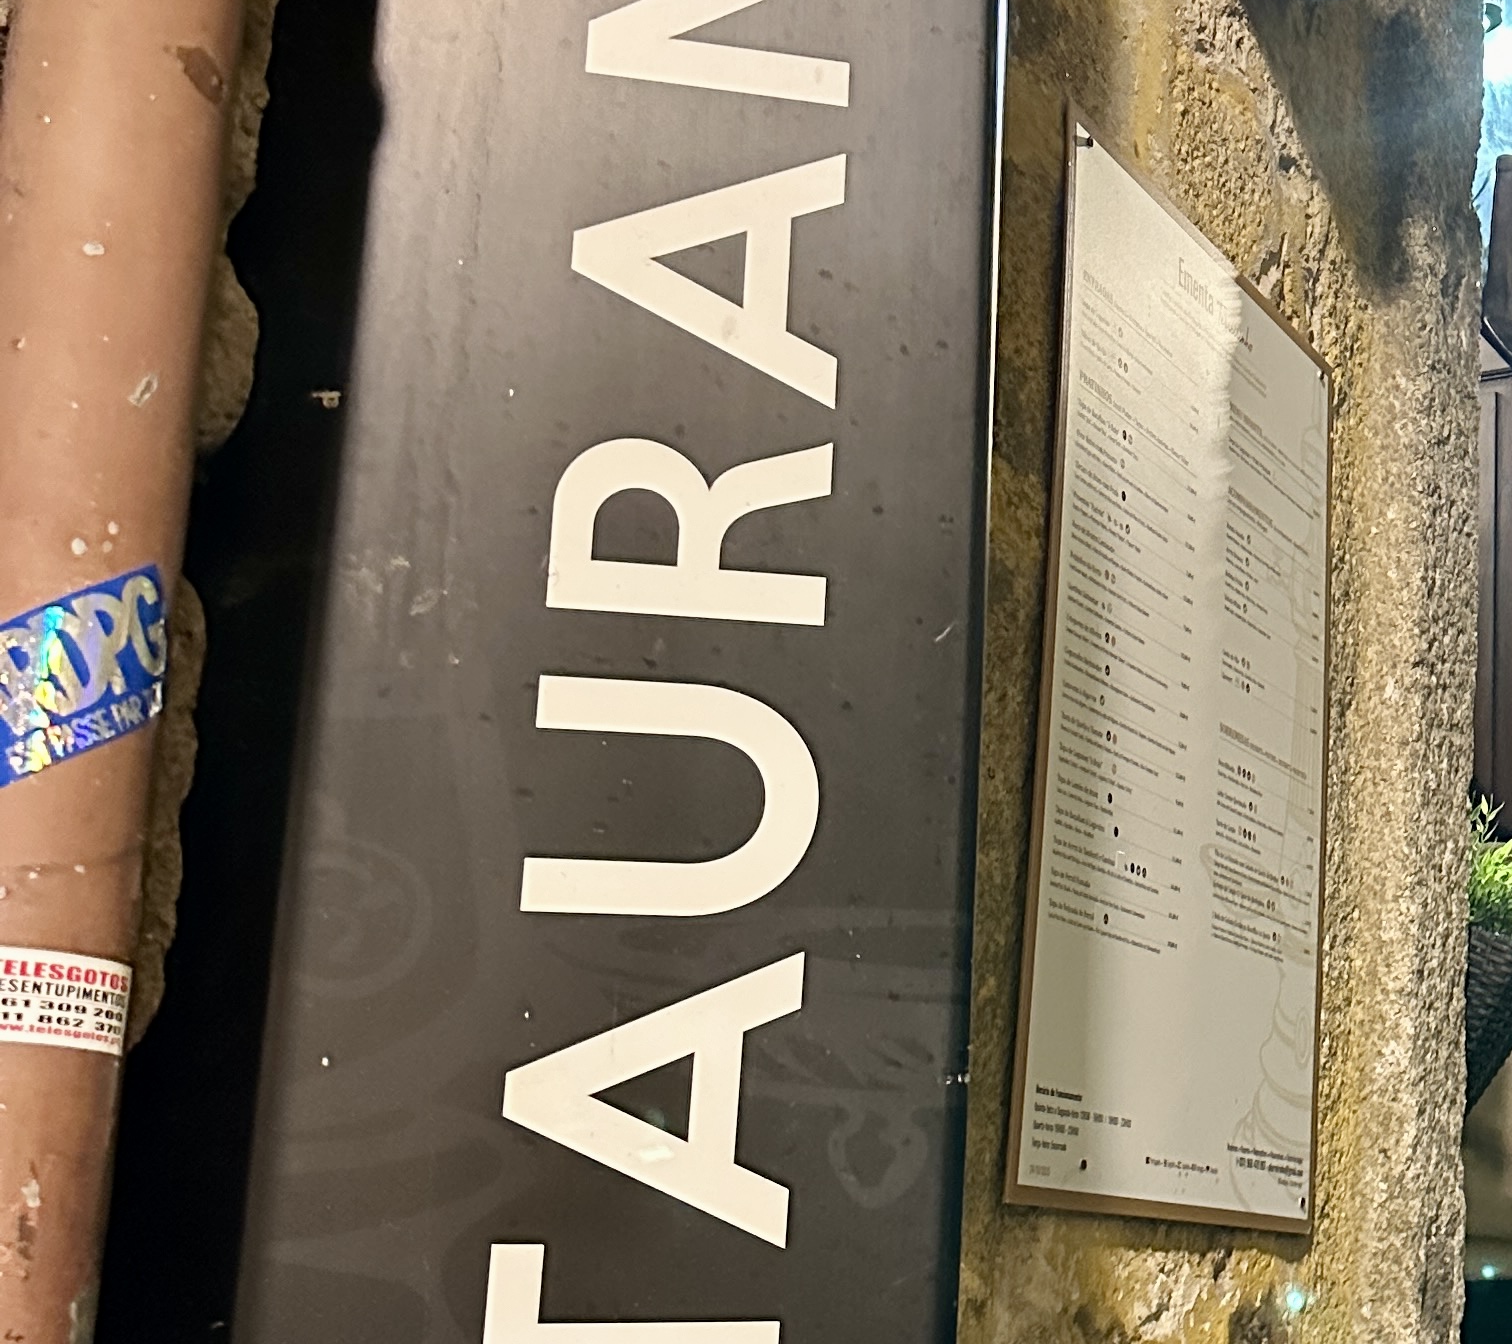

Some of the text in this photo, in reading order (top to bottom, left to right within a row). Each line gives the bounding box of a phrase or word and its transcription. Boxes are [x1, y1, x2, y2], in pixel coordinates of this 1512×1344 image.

[1178, 256, 1214, 316] Ementa
[0, 959, 128, 993] ELESGOTOS
[39, 1000, 88, 1015] 309
[38, 1014, 85, 1029] 862
